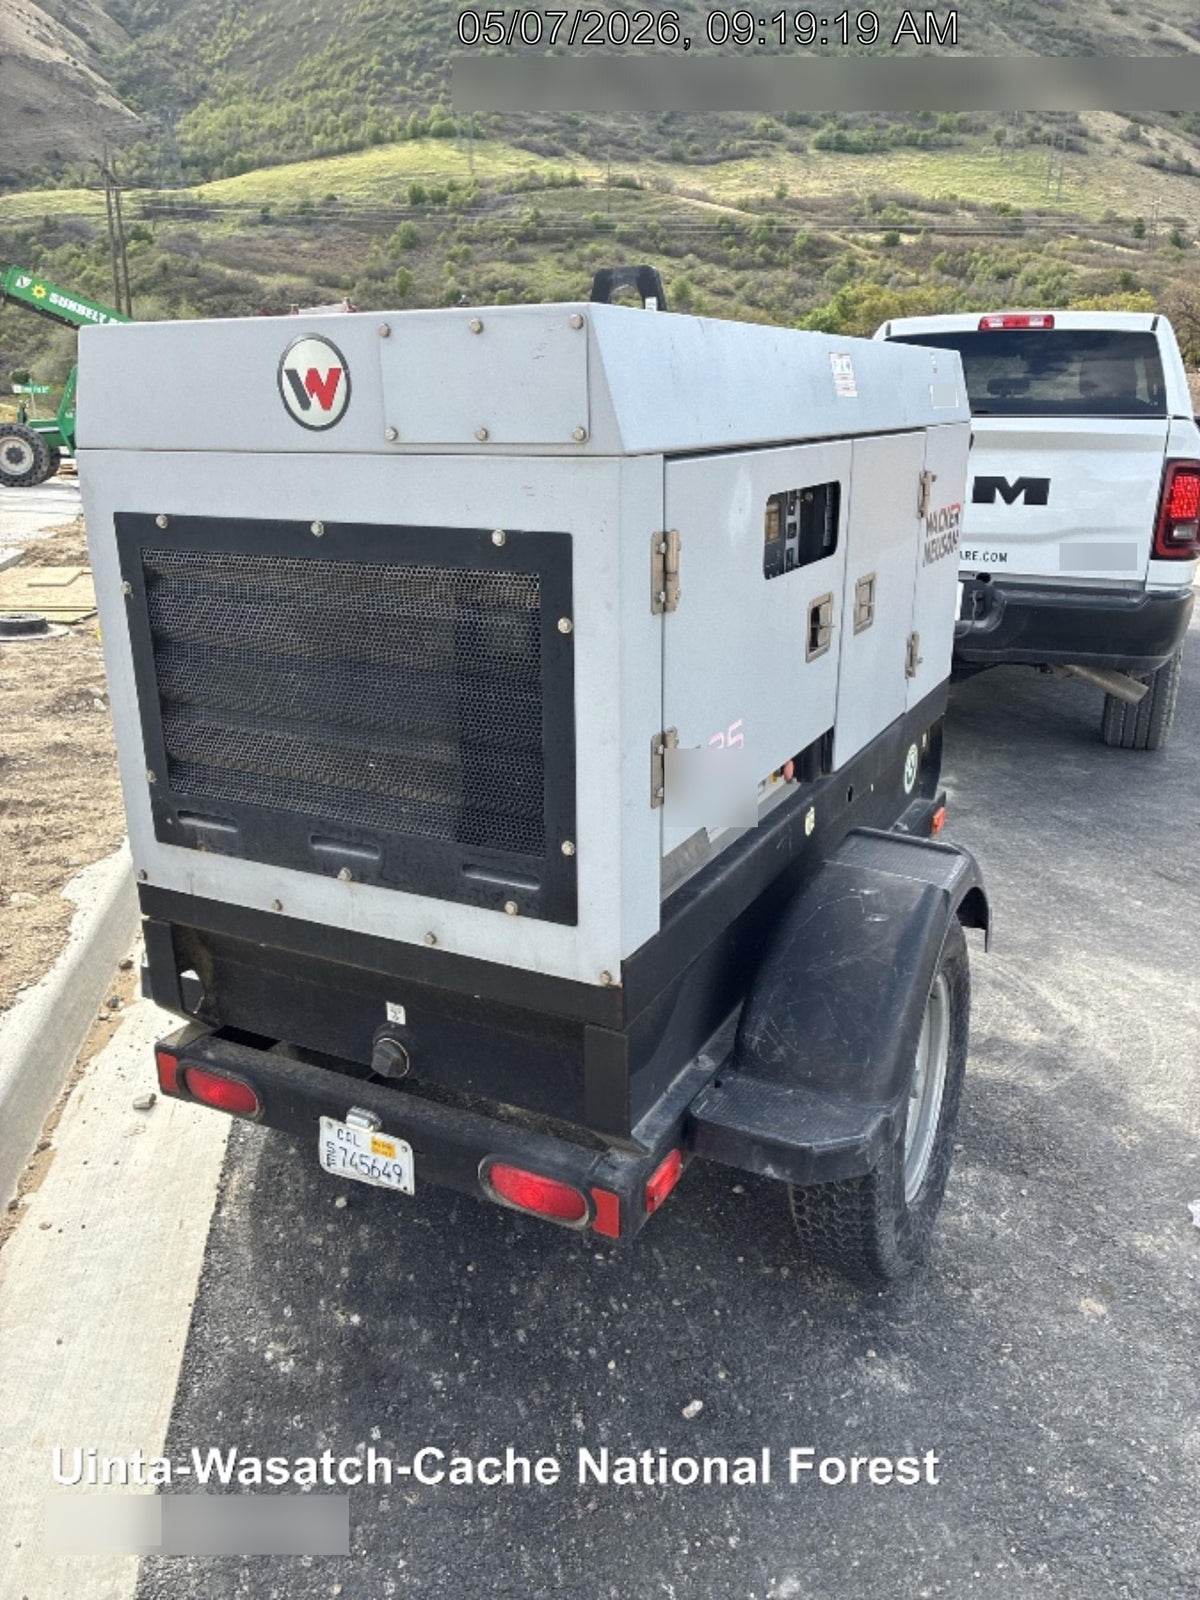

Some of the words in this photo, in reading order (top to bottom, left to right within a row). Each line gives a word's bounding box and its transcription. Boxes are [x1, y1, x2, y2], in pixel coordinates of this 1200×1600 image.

[50, 293, 107, 324] SUNBELT
[284, 367, 342, 411] W
[337, 1128, 360, 1147] CAL
[338, 1146, 403, 1183] 745649
